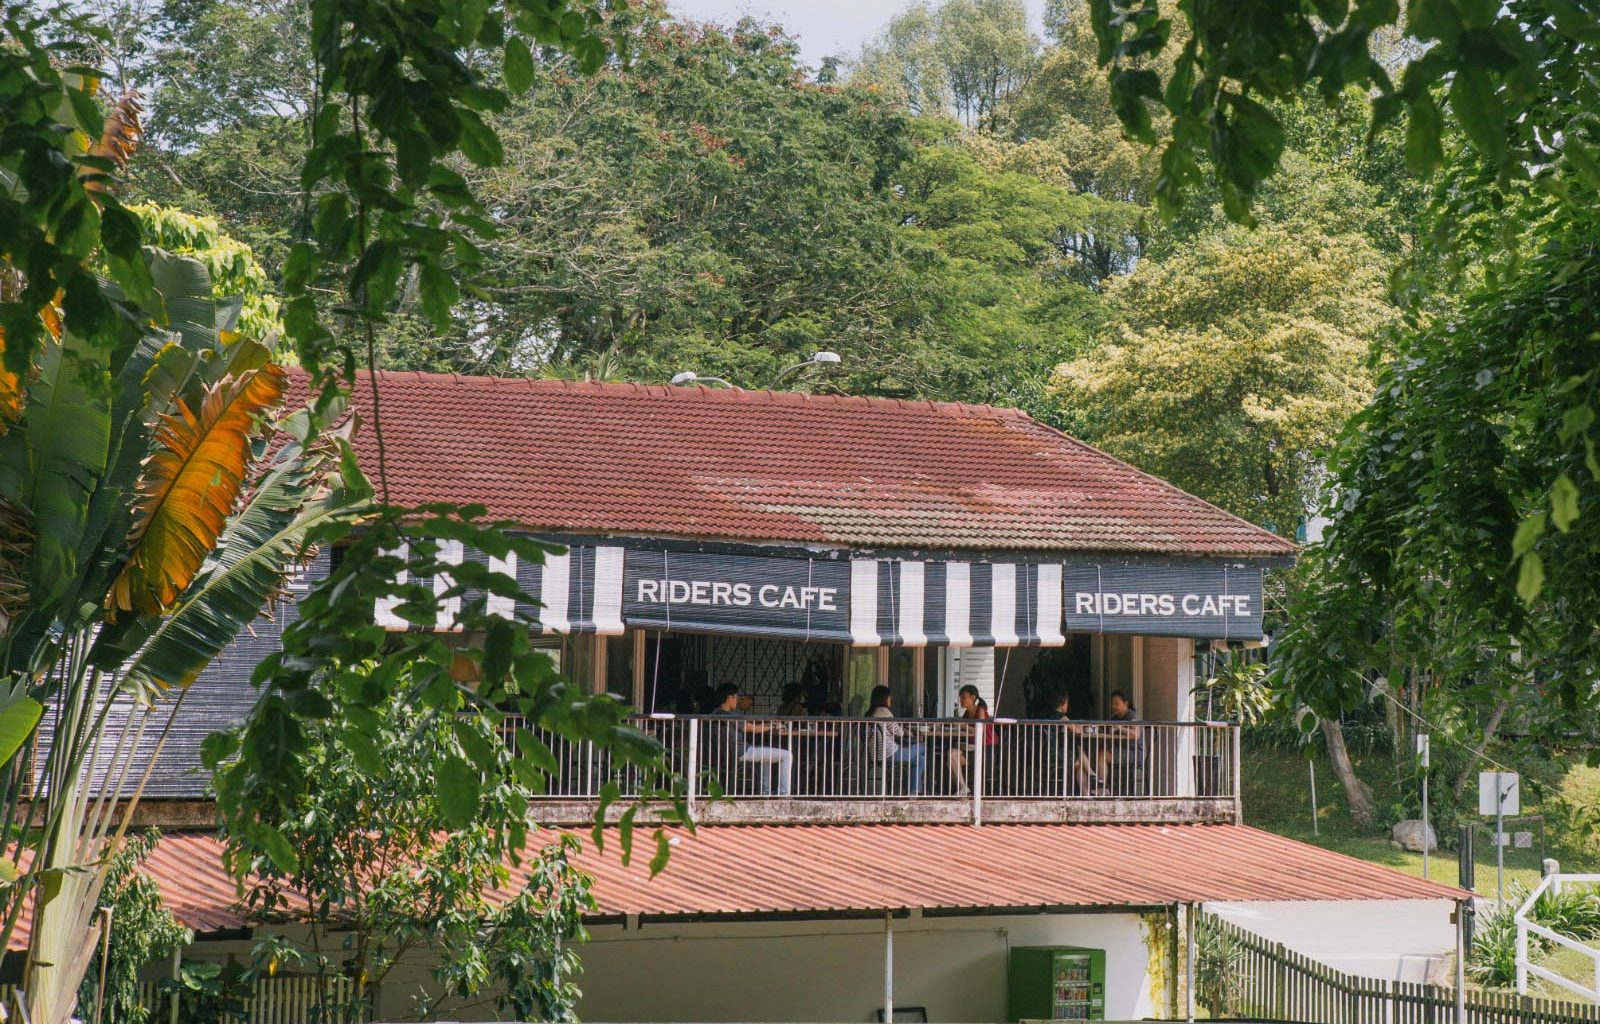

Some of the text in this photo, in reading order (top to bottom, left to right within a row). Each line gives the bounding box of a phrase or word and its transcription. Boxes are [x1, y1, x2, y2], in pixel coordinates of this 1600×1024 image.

[637, 579, 837, 611] RIDERS CAFE
[1075, 592, 1251, 617] RIDERS CAFE
